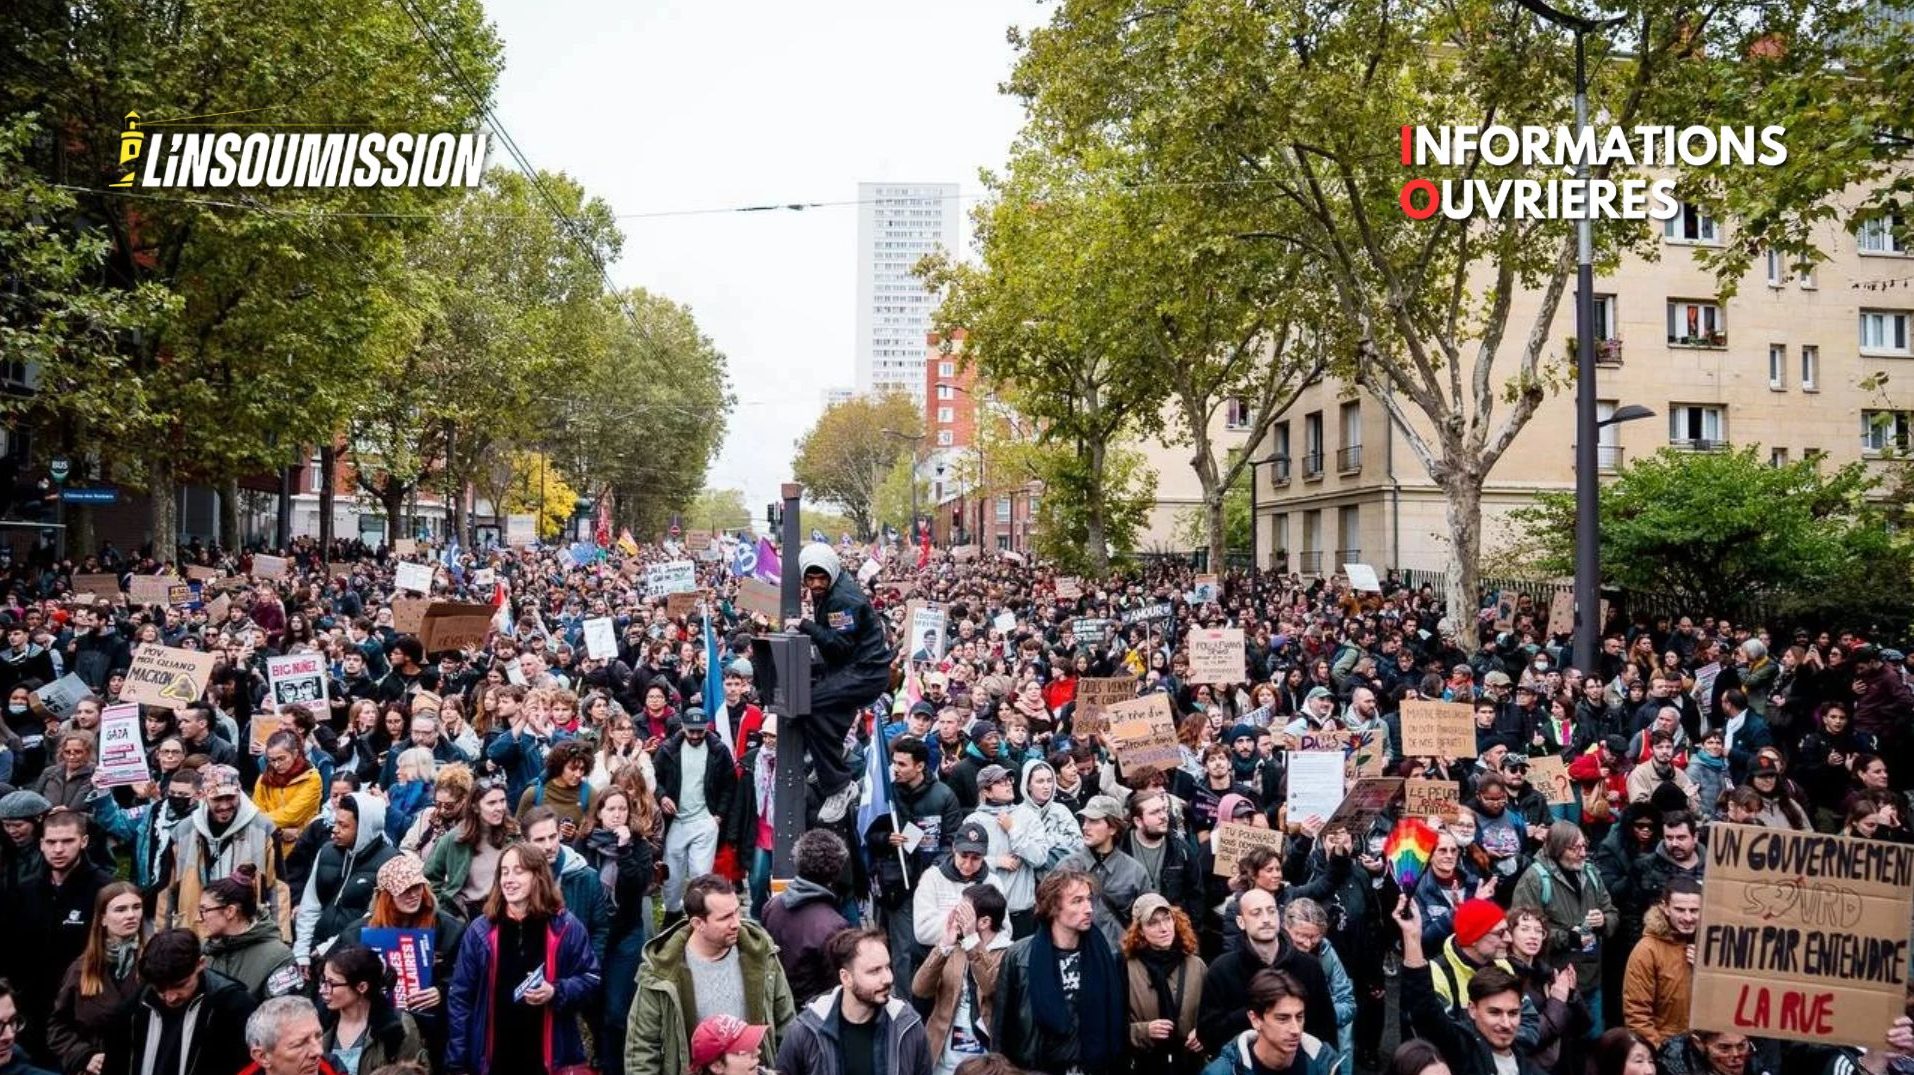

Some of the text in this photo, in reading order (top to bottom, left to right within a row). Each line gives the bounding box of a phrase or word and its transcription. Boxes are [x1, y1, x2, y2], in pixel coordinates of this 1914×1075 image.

[1130, 604, 1163, 622] AMOUR
[157, 659, 196, 671] QUAND
[271, 664, 291, 677] BIG
[128, 666, 175, 685] MACRON
[1112, 709, 1123, 723] Je
[106, 727, 128, 740] GAZA
[1409, 788, 1425, 798] LE
[1714, 827, 1914, 887] UN GOUVERNEMENT
[1704, 925, 1907, 984] FINIT PAR ENTENDRE
[402, 943, 421, 994] ALAIRES
[1734, 984, 1834, 1035] LA RUE
